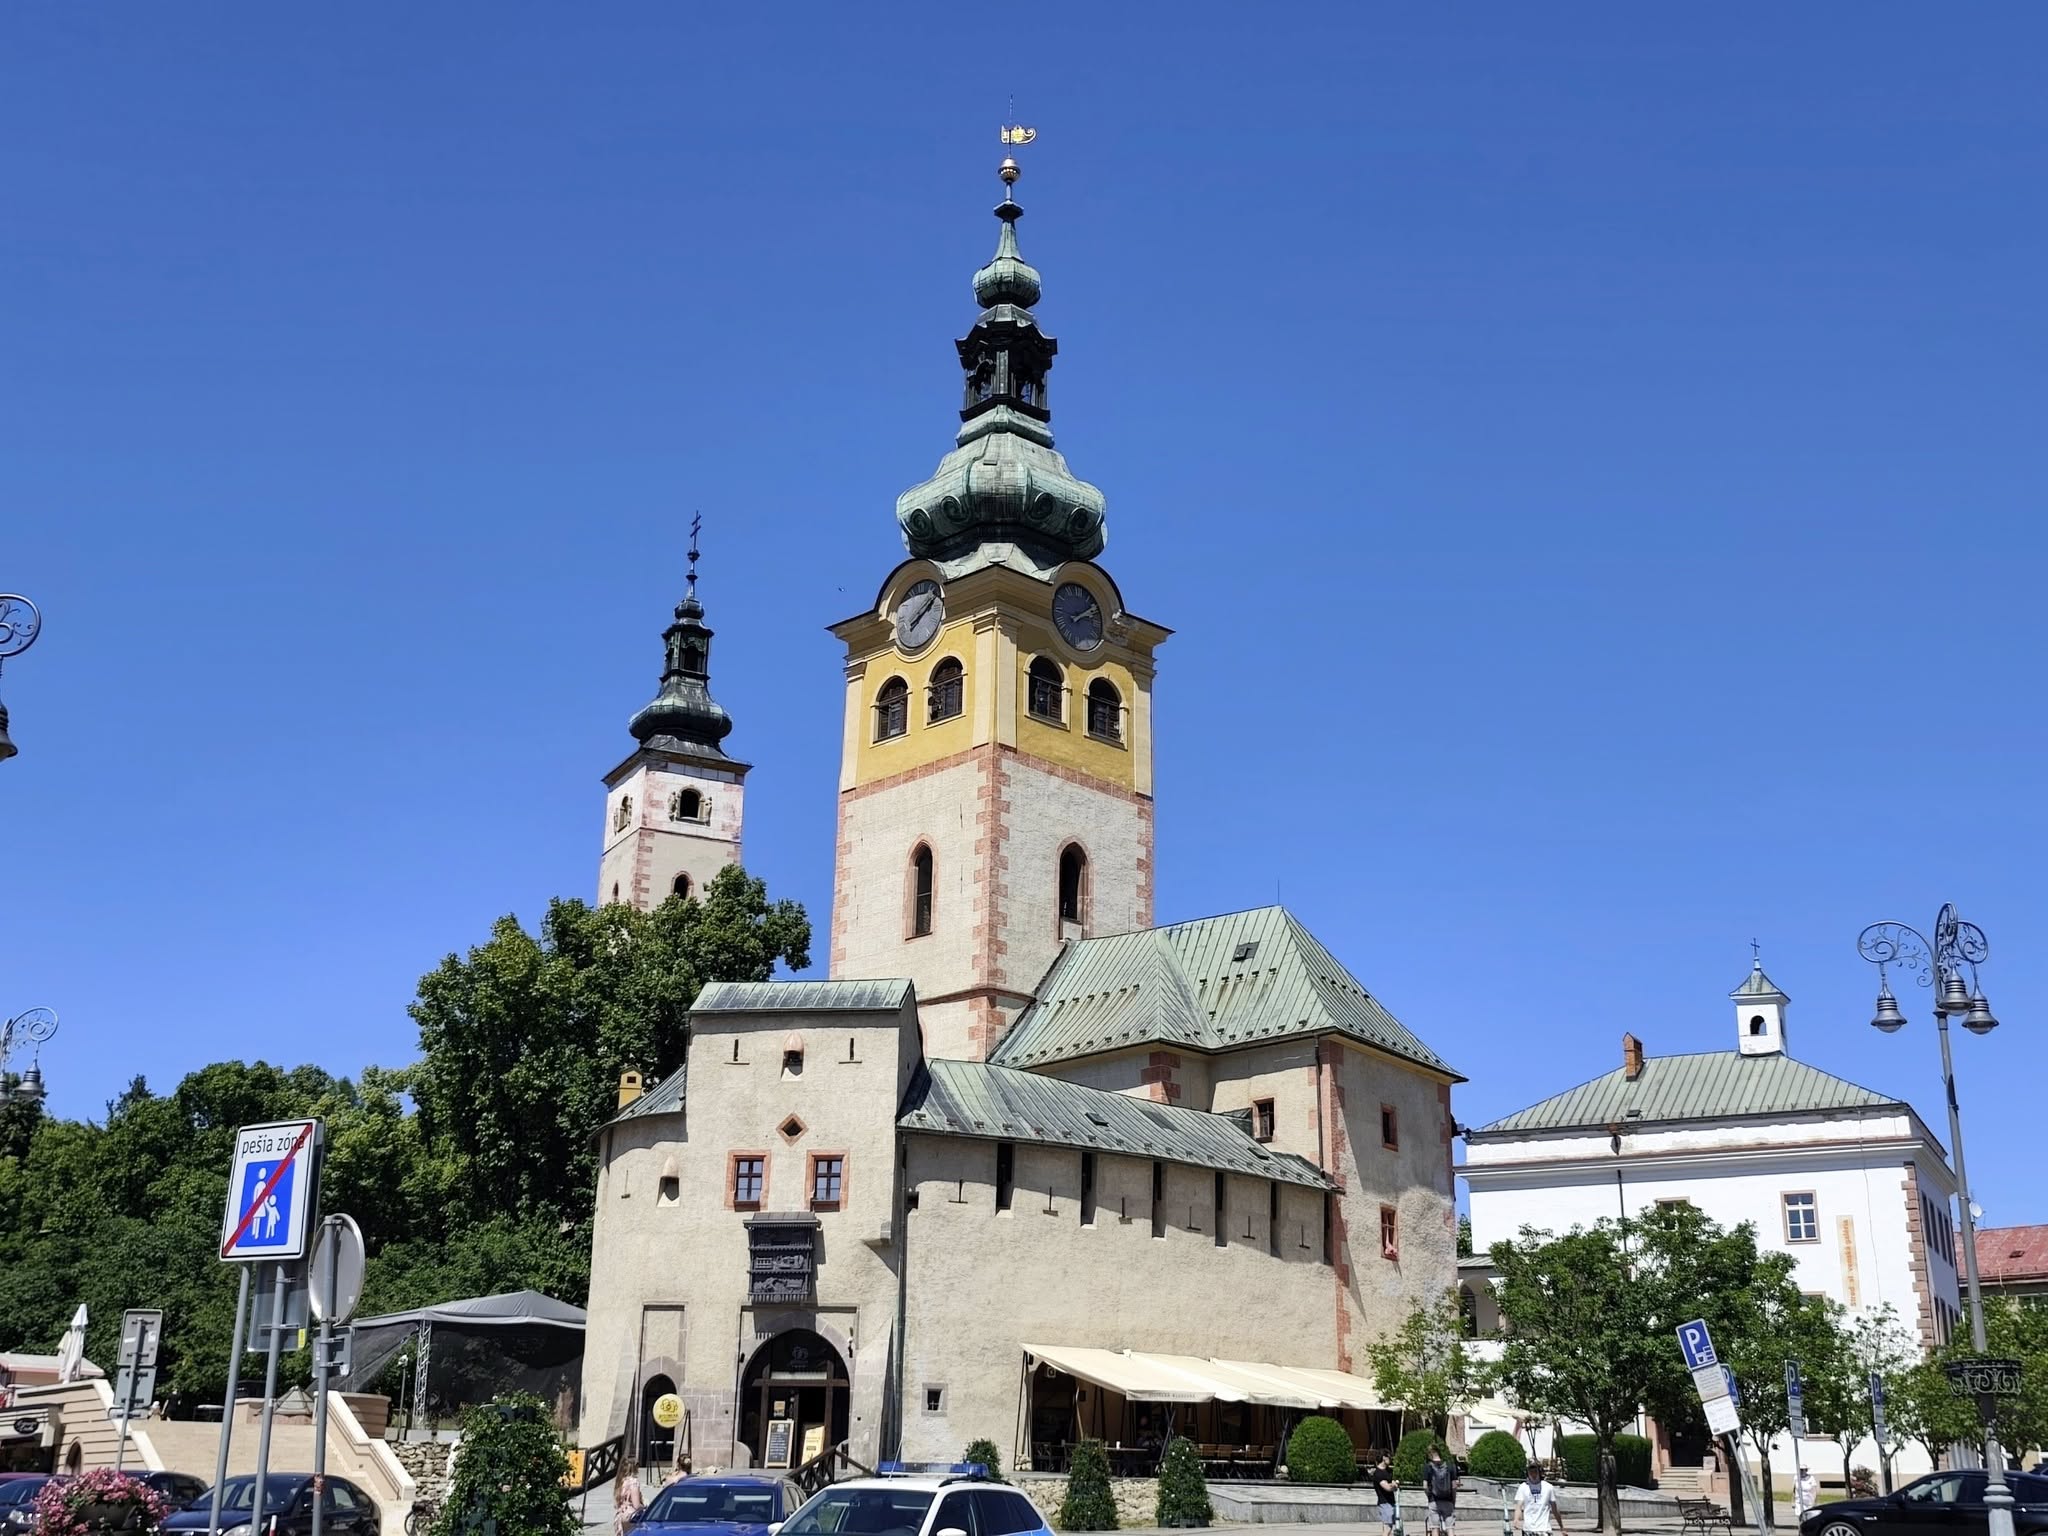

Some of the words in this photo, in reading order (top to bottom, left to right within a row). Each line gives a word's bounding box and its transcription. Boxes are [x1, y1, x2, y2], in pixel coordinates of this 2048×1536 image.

[242, 1134, 273, 1158] pešia
[1685, 1328, 1701, 1355] P
[1788, 1366, 1796, 1392] P
[1873, 1377, 1880, 1399] P
